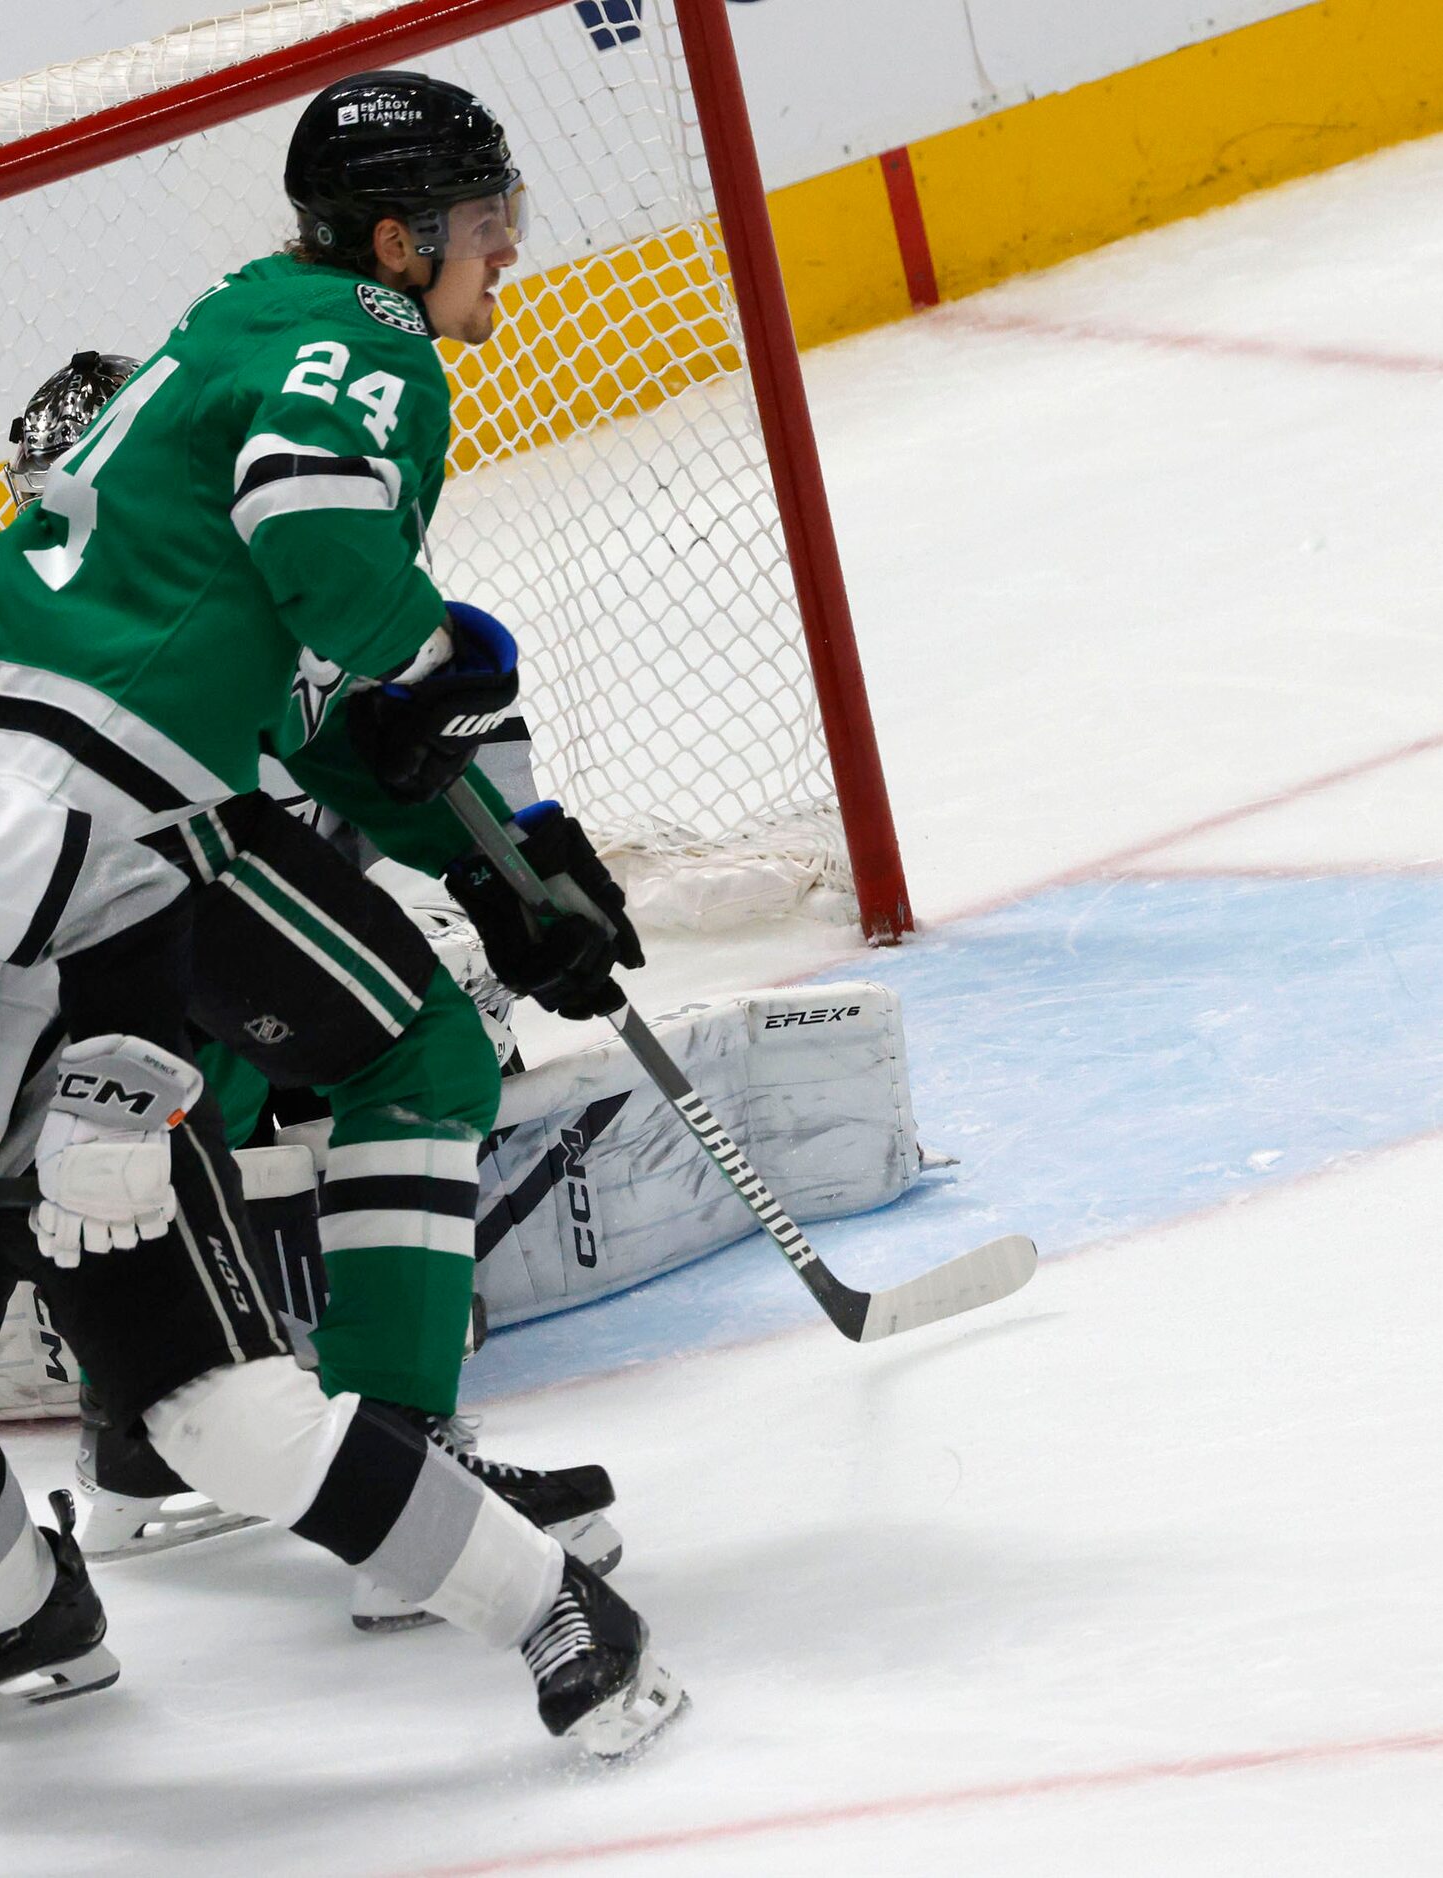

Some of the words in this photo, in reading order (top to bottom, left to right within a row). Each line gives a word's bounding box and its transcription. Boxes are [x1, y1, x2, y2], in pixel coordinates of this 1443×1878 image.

[361, 101, 409, 112] ENERGY
[362, 111, 422, 122] TRANSFER
[281, 341, 406, 451] 24
[470, 866, 493, 886] 24
[143, 1054, 179, 1077] SPENCE
[56, 1073, 156, 1116] CM
[674, 1090, 819, 1270] WARRIOR
[561, 1128, 598, 1269] CCM
